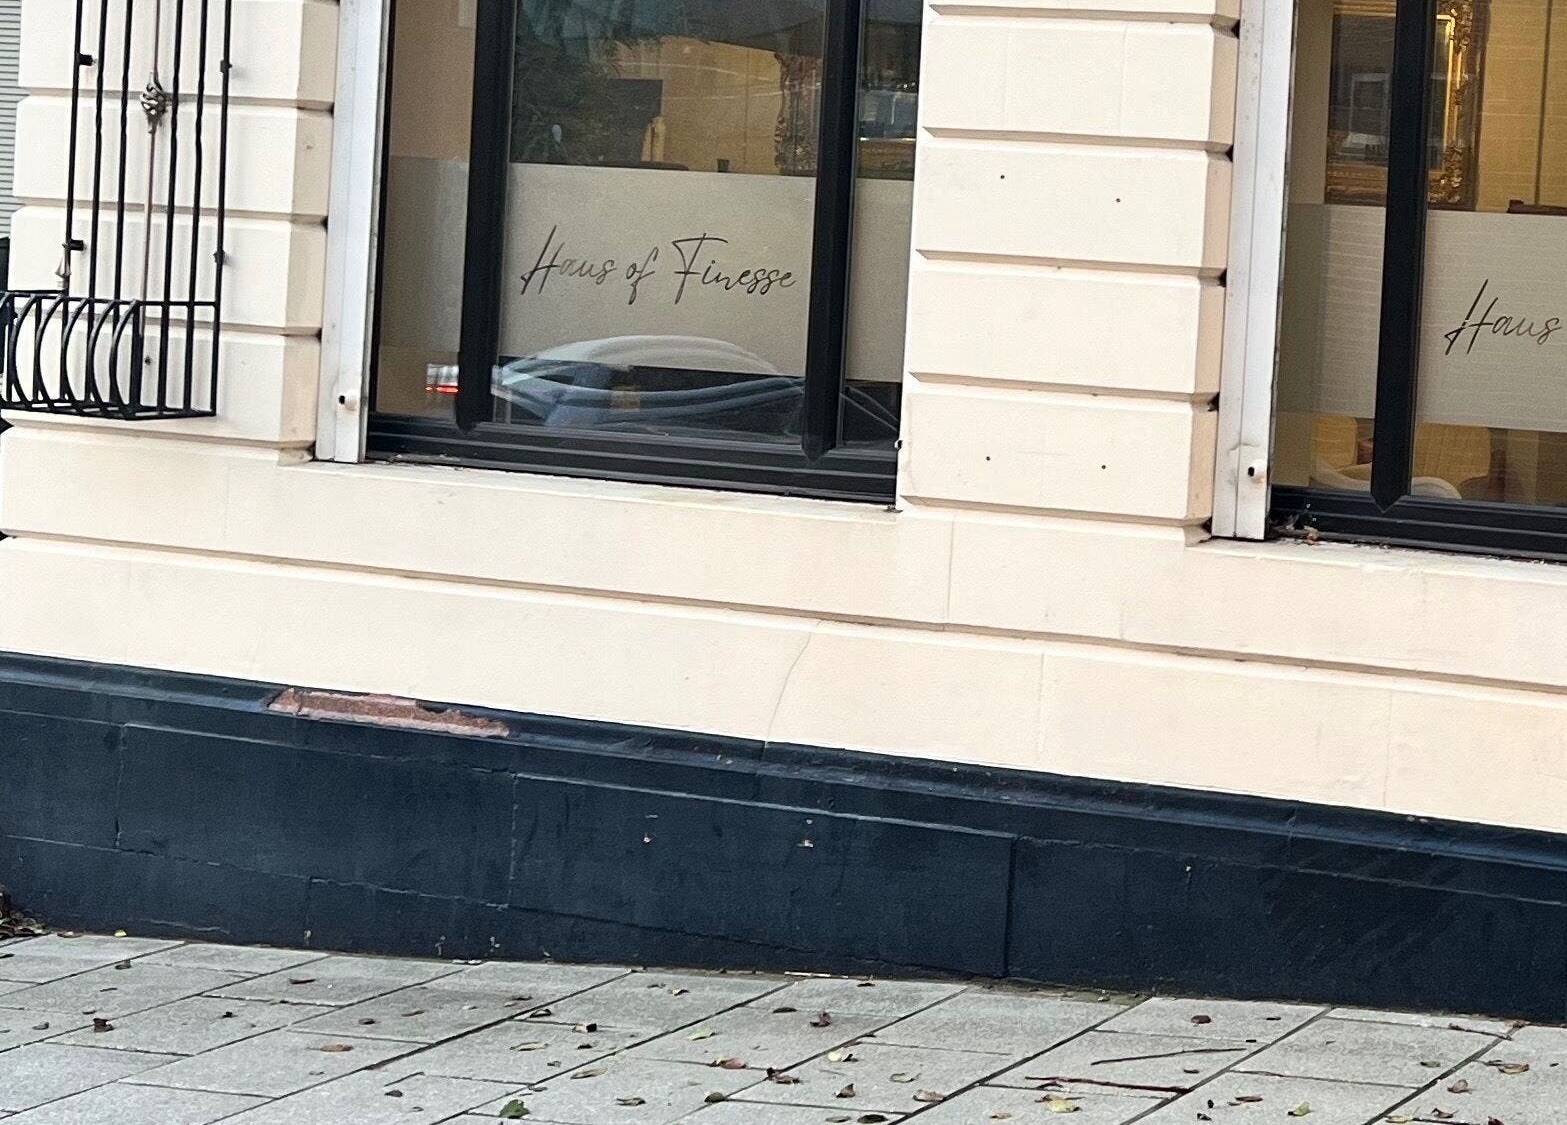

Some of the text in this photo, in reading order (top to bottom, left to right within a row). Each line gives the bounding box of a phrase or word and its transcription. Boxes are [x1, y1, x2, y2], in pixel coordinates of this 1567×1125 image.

[520, 225, 797, 305] Haus of Finesse
[1444, 279, 1563, 355] Haus
